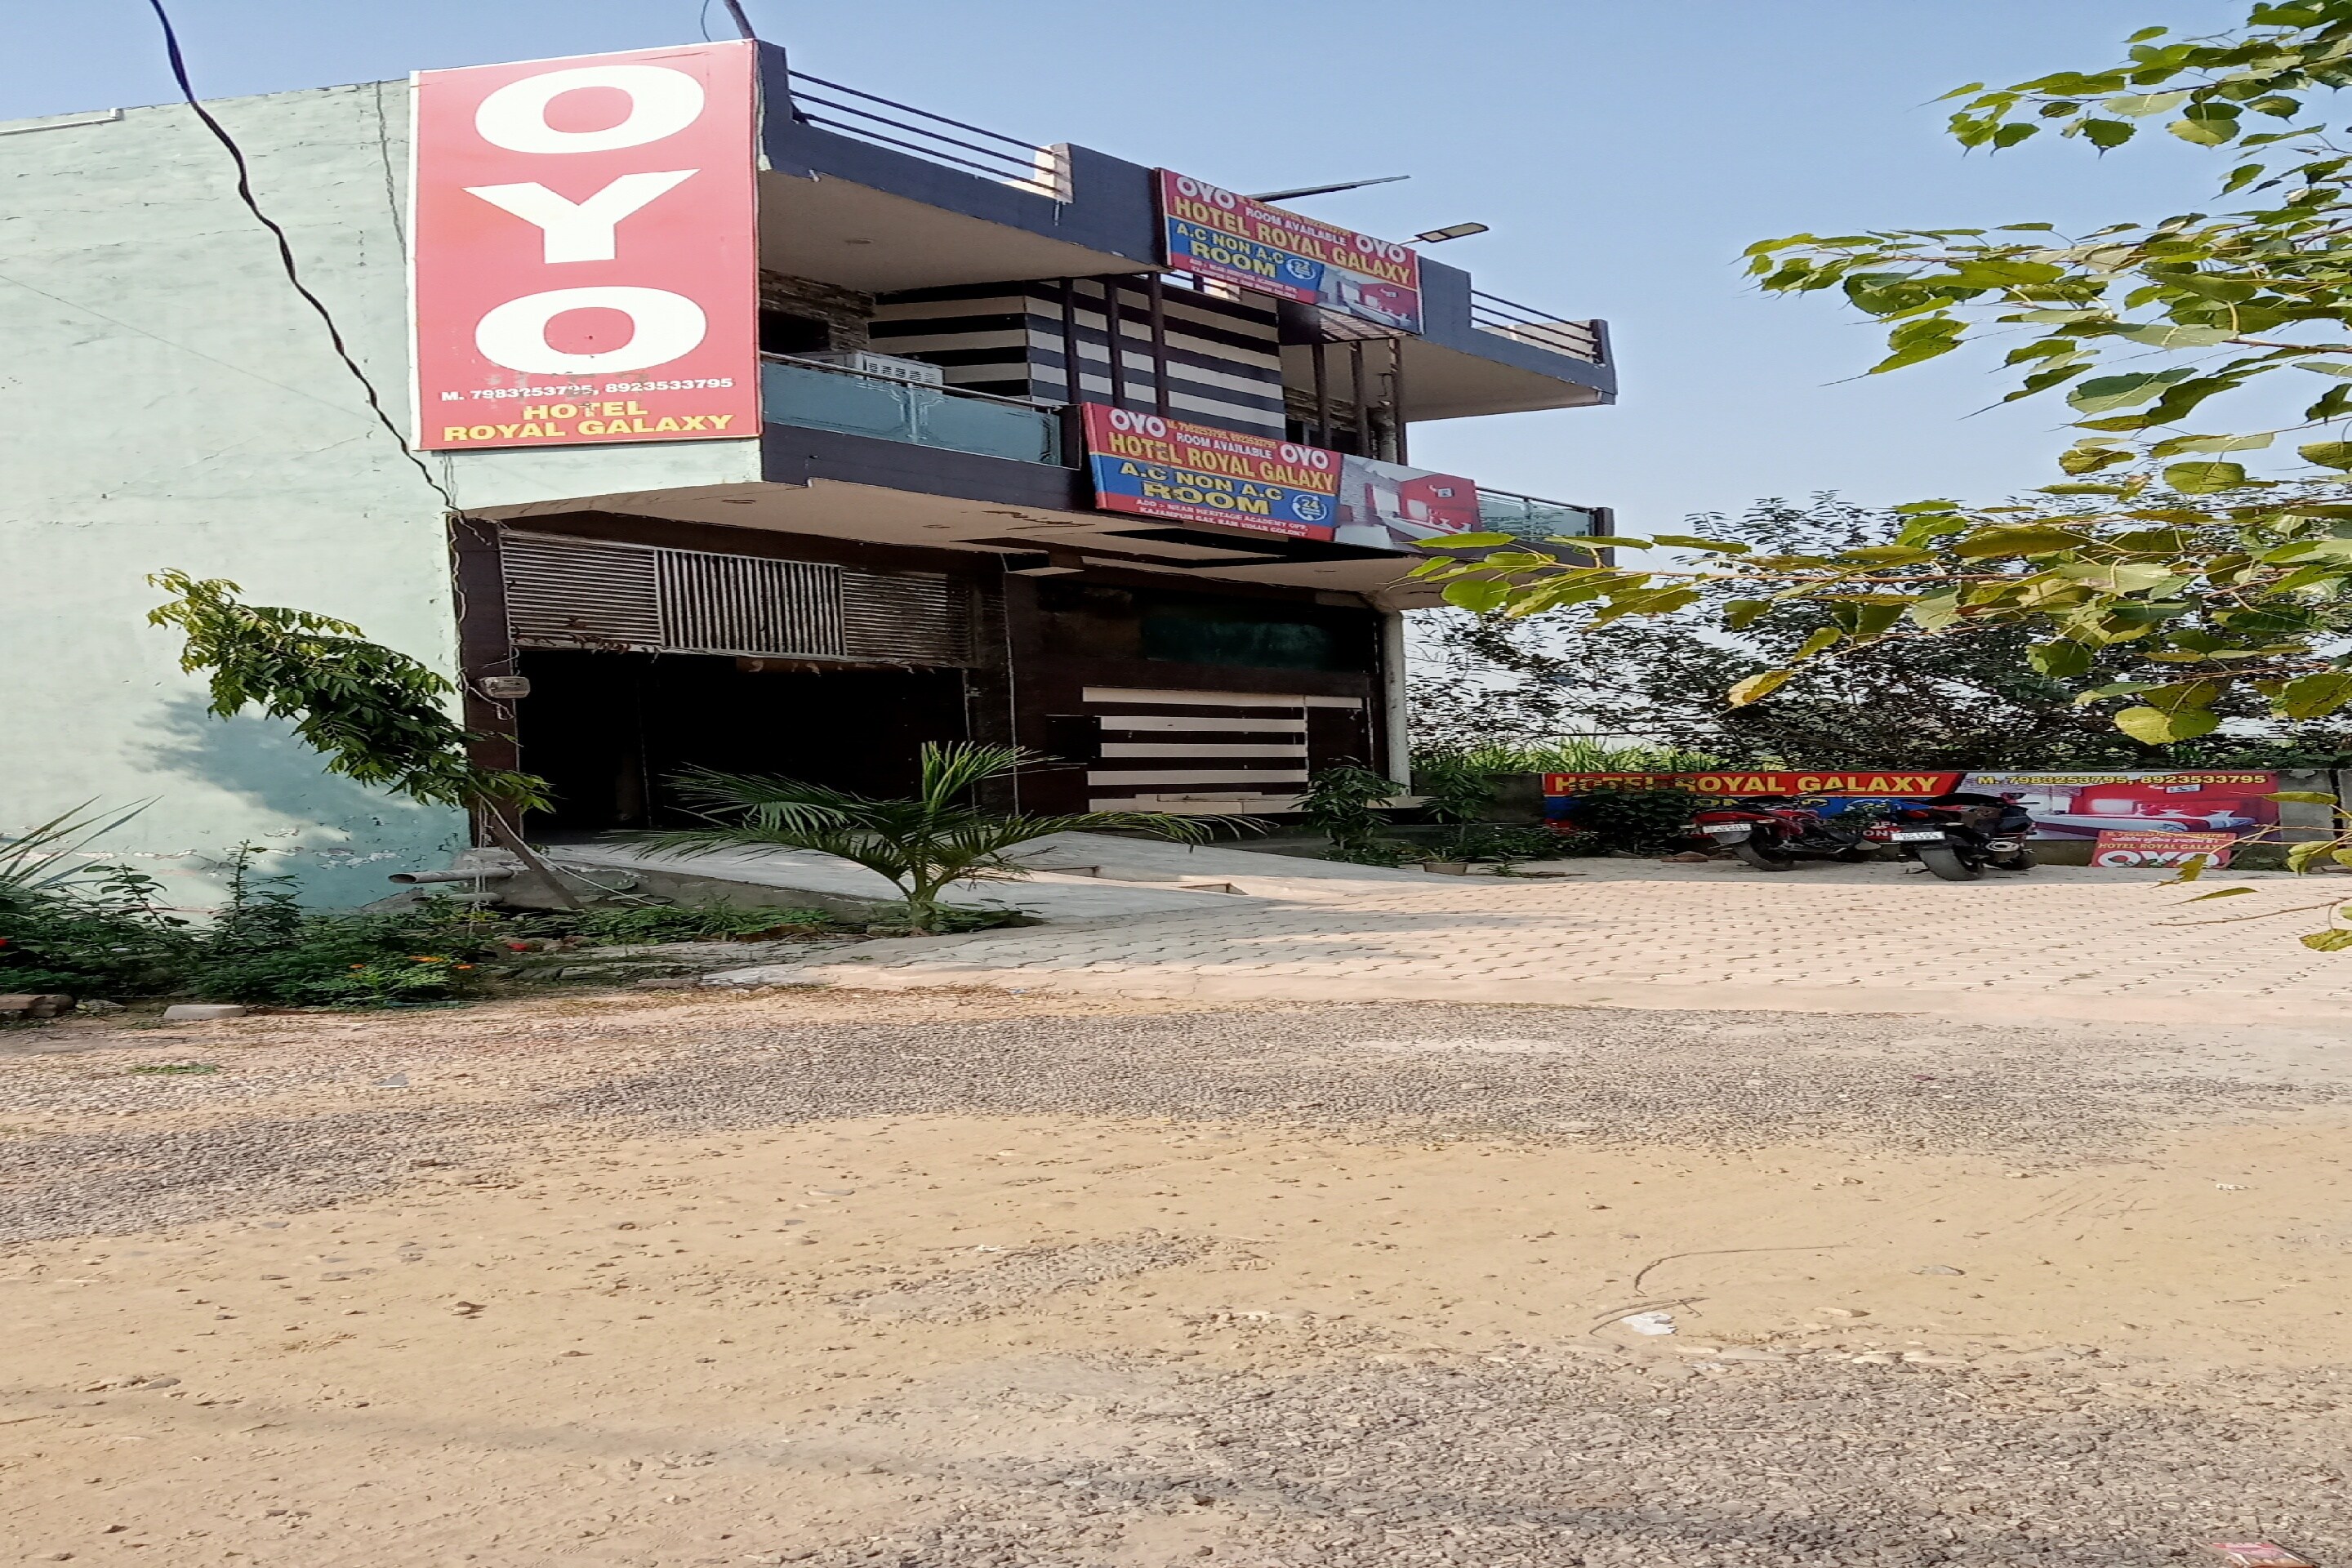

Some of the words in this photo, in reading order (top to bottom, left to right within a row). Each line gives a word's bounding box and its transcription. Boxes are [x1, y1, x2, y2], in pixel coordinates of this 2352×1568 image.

[1176, 176, 1236, 210] OYO
[461, 64, 707, 375] OYO
[1245, 207, 1282, 226] ROOM
[1285, 220, 1348, 246] AVAILABLE
[1174, 196, 1252, 237] HOTEL
[1258, 222, 1327, 261] ROYAL
[1333, 245, 1412, 284] GALAXY
[1177, 224, 1207, 241] A.C
[1212, 233, 1251, 255] NON
[1258, 247, 1285, 265] A.C
[1356, 234, 1406, 263] OYO
[1190, 240, 1276, 278] ROOM
[441, 391, 465, 402] M.
[605, 378, 733, 394] 8923533795
[523, 400, 648, 420] HOTEL
[1109, 408, 1167, 438] OYO
[443, 421, 566, 442] ROYAL
[577, 415, 735, 435] GALAXY
[1108, 431, 1179, 470] HOTEL
[1188, 448, 1256, 479] ROYAL
[1259, 464, 1335, 492] GALAXY
[1176, 432, 1211, 448] ROOM
[1214, 439, 1273, 460] AVAILABLE
[1280, 443, 1329, 470] OYO
[1120, 462, 1167, 482] A.C
[1176, 472, 1236, 493] NON
[1241, 483, 1283, 501] A.C
[1143, 482, 1270, 515] ROOM
[1675, 776, 1786, 792] ROYAL
[1797, 776, 1940, 792] GALAXY
[1977, 777, 2000, 785] M.
[2140, 775, 2266, 785] 8923533795
